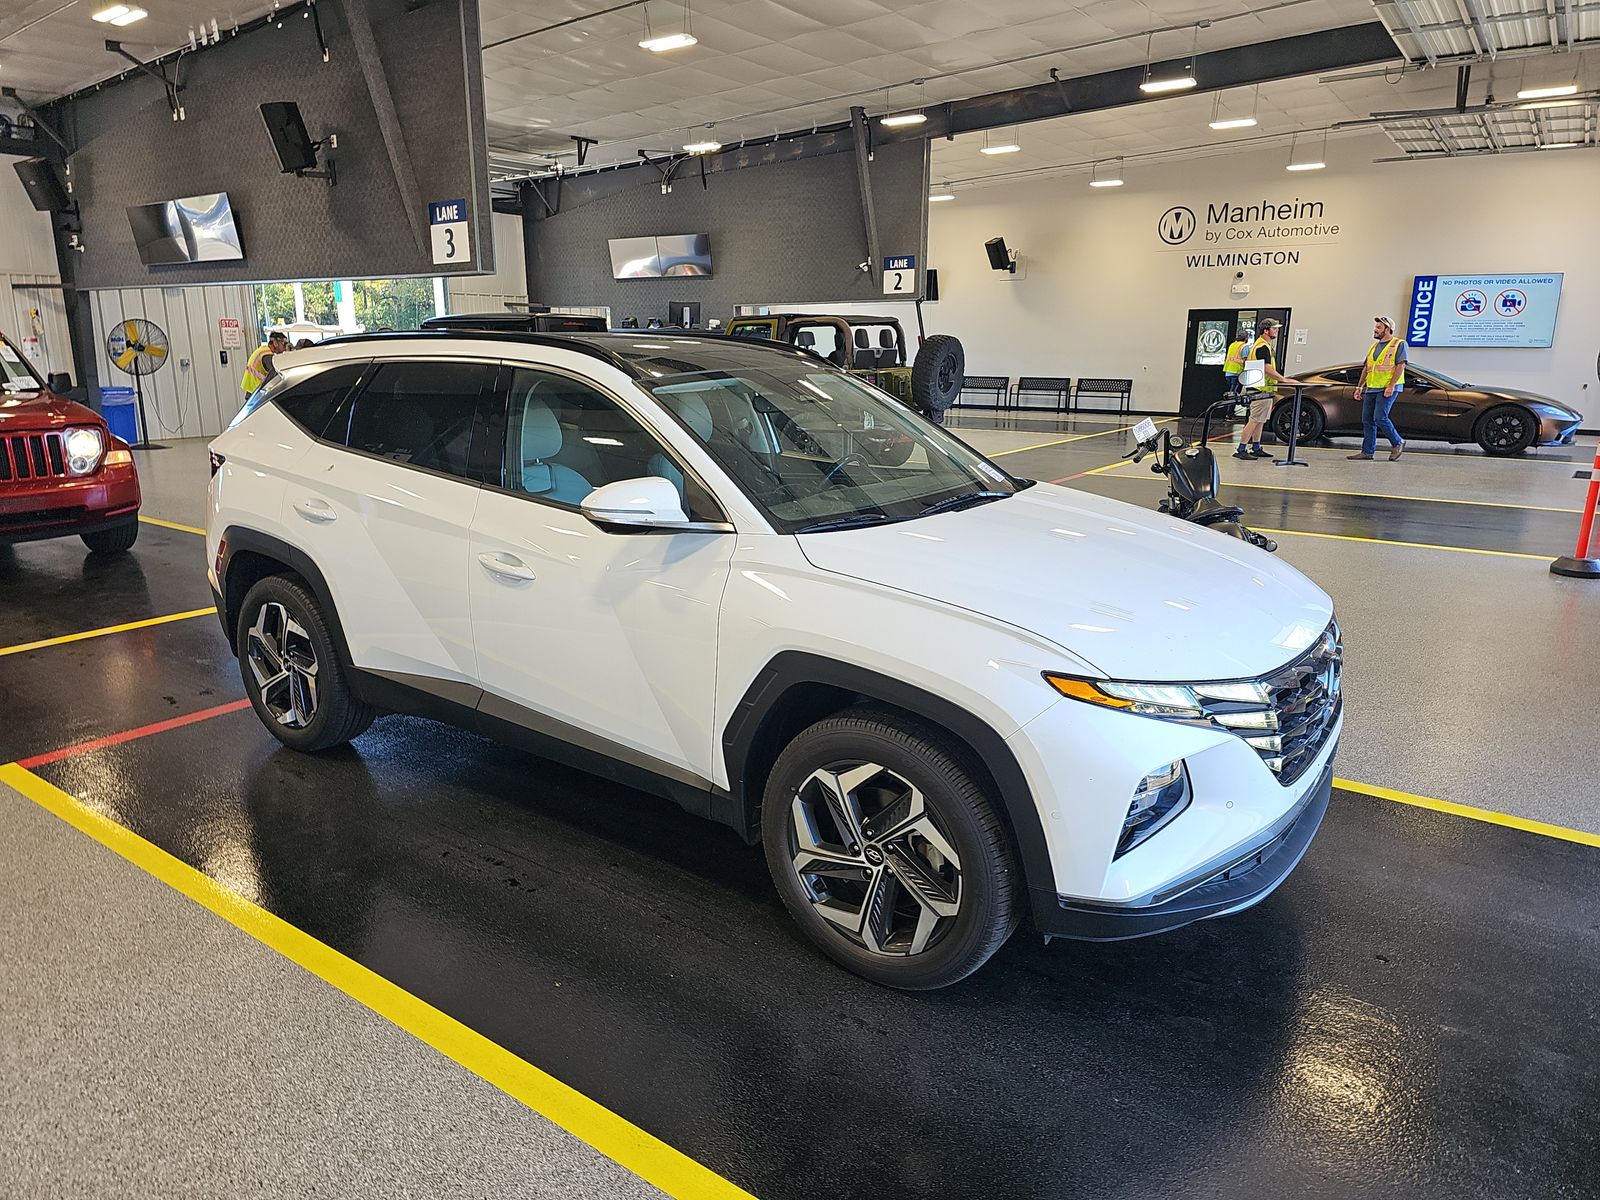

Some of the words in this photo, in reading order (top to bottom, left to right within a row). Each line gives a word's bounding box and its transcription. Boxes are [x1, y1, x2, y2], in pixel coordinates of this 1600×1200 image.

[436, 204, 459, 222] LANE
[1207, 198, 1324, 224] Manheim
[1205, 230, 1222, 244] by
[1225, 228, 1253, 240] Cox
[1257, 223, 1340, 239] Automotive
[444, 228, 456, 258] 3
[890, 259, 909, 268] LANE
[1186, 251, 1300, 268] WILMINGTON
[893, 273, 902, 290] 2
[1411, 280, 1434, 342] NOTICE
[221, 320, 238, 328] STOP
